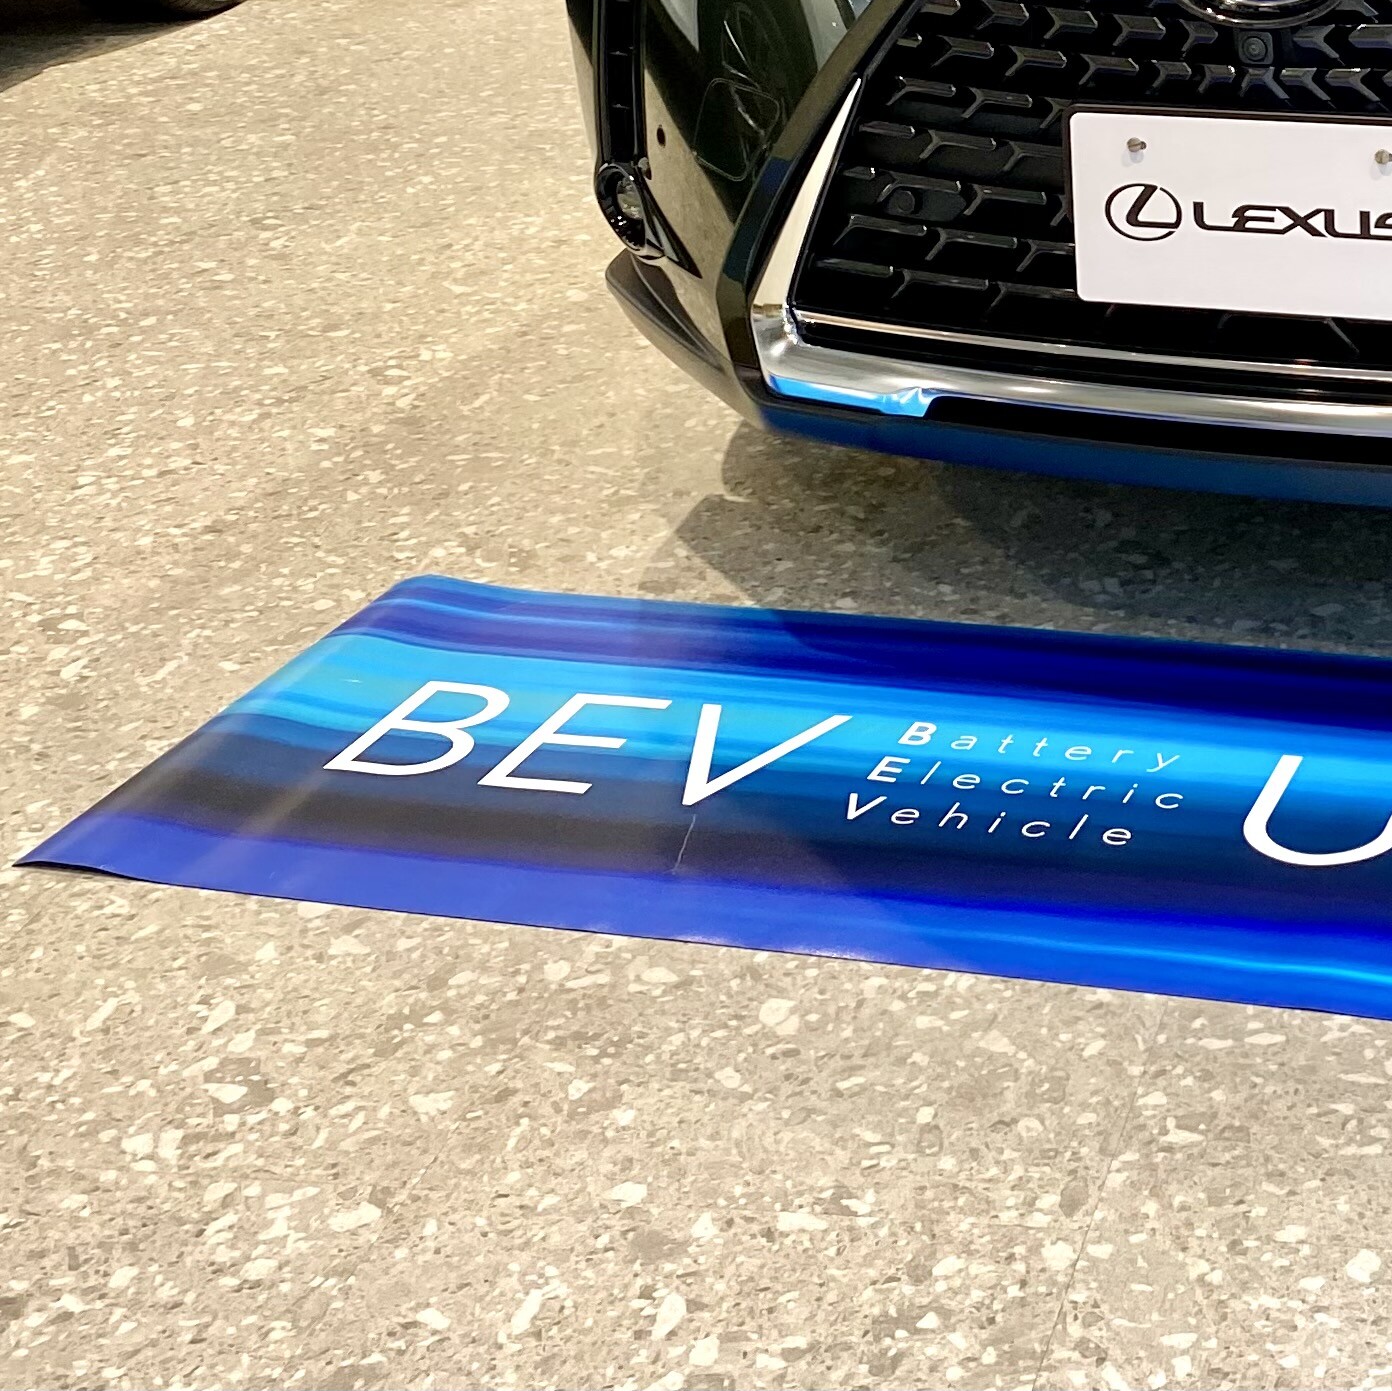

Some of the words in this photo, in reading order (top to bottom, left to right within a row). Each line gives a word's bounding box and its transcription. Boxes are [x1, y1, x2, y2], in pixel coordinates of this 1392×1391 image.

[322, 679, 854, 807] BEV
[897, 720, 1181, 773] Battery
[866, 755, 1184, 810] Electric
[845, 792, 1133, 847] Vehicle
